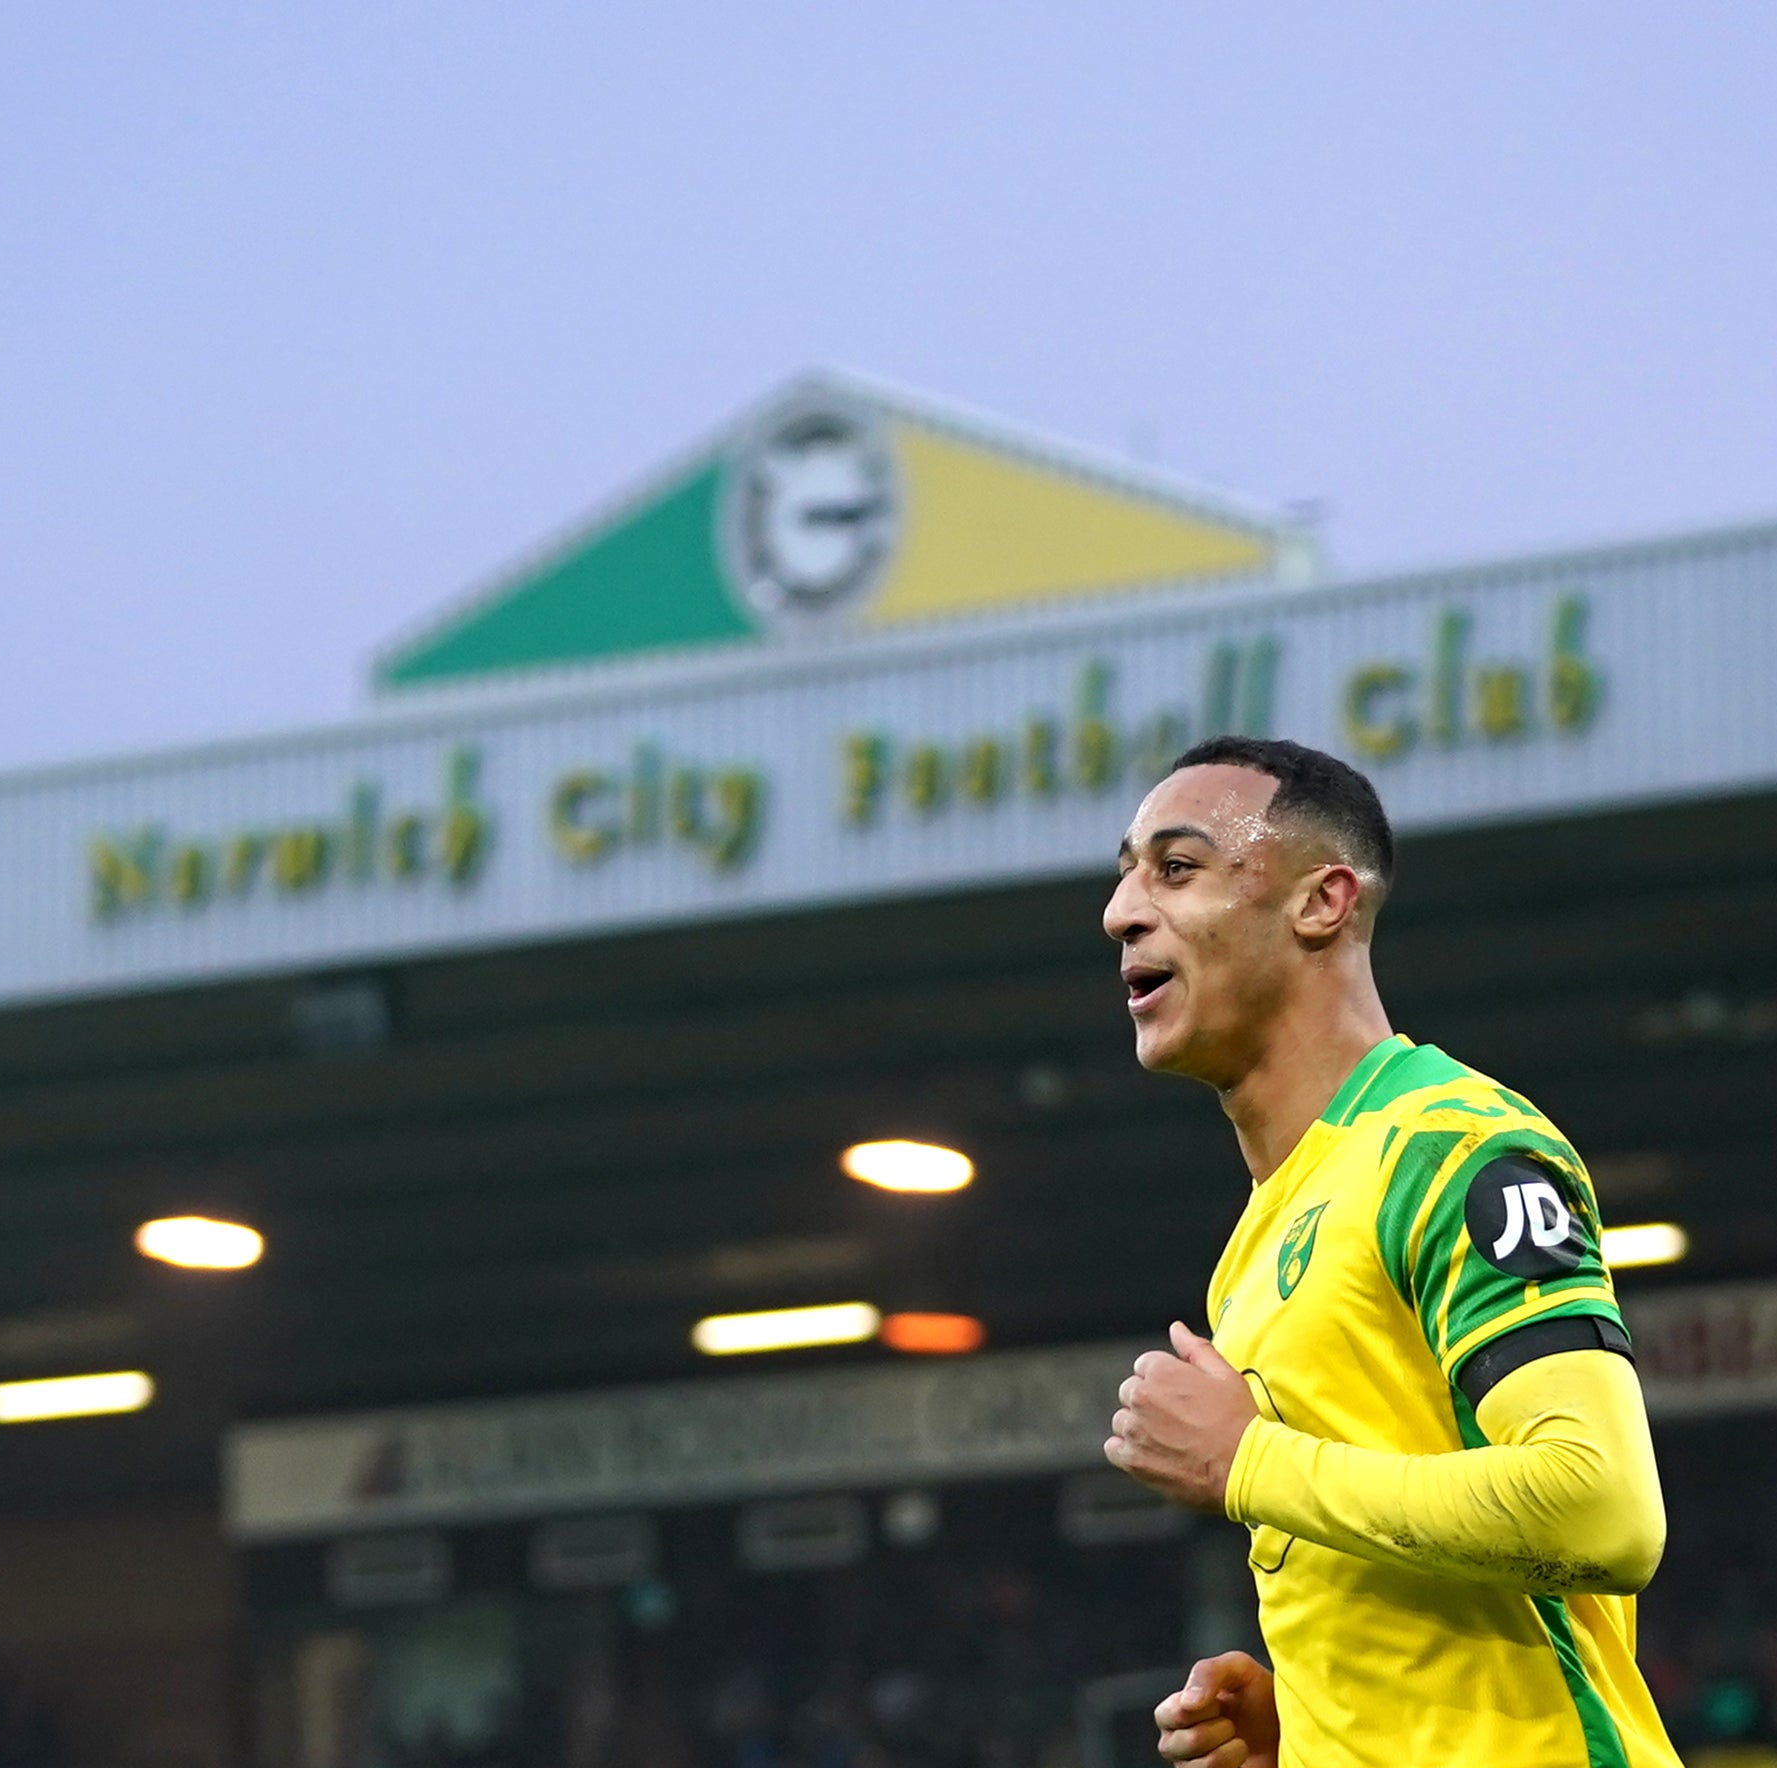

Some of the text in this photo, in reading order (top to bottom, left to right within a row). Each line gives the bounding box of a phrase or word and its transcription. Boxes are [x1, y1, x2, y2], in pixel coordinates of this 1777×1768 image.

[87, 742, 488, 923] Norwich
[547, 737, 765, 867] City
[1493, 1183, 1570, 1260] JD
